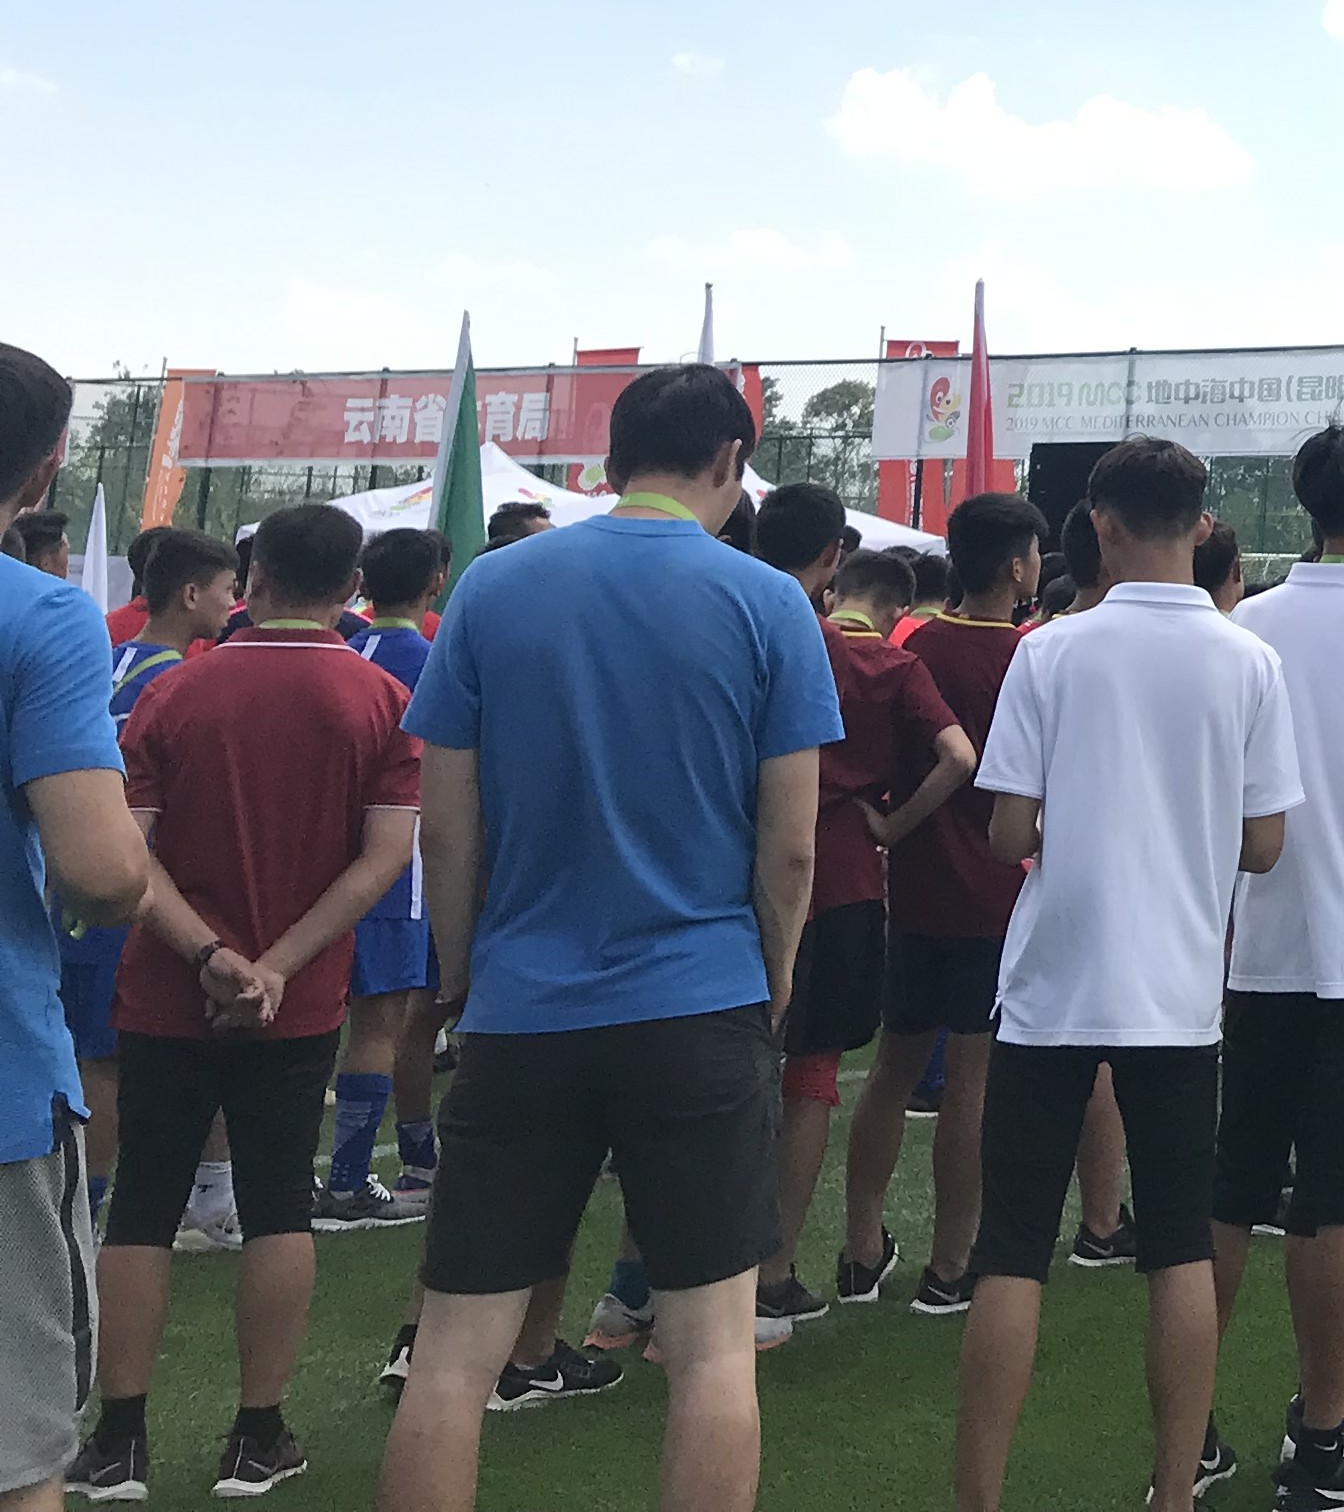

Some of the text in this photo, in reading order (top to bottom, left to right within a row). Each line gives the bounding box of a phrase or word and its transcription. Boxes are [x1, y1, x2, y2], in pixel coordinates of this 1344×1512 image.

[1007, 381, 1074, 408] 2019
[1078, 379, 1142, 407] MCC
[344, 391, 550, 444] 云南省育局
[1006, 416, 1037, 431] 2019
[1042, 415, 1075, 431] MCC
[1081, 413, 1209, 430] MEDITERRANEAN
[1214, 408, 1300, 428] CHAMPION
